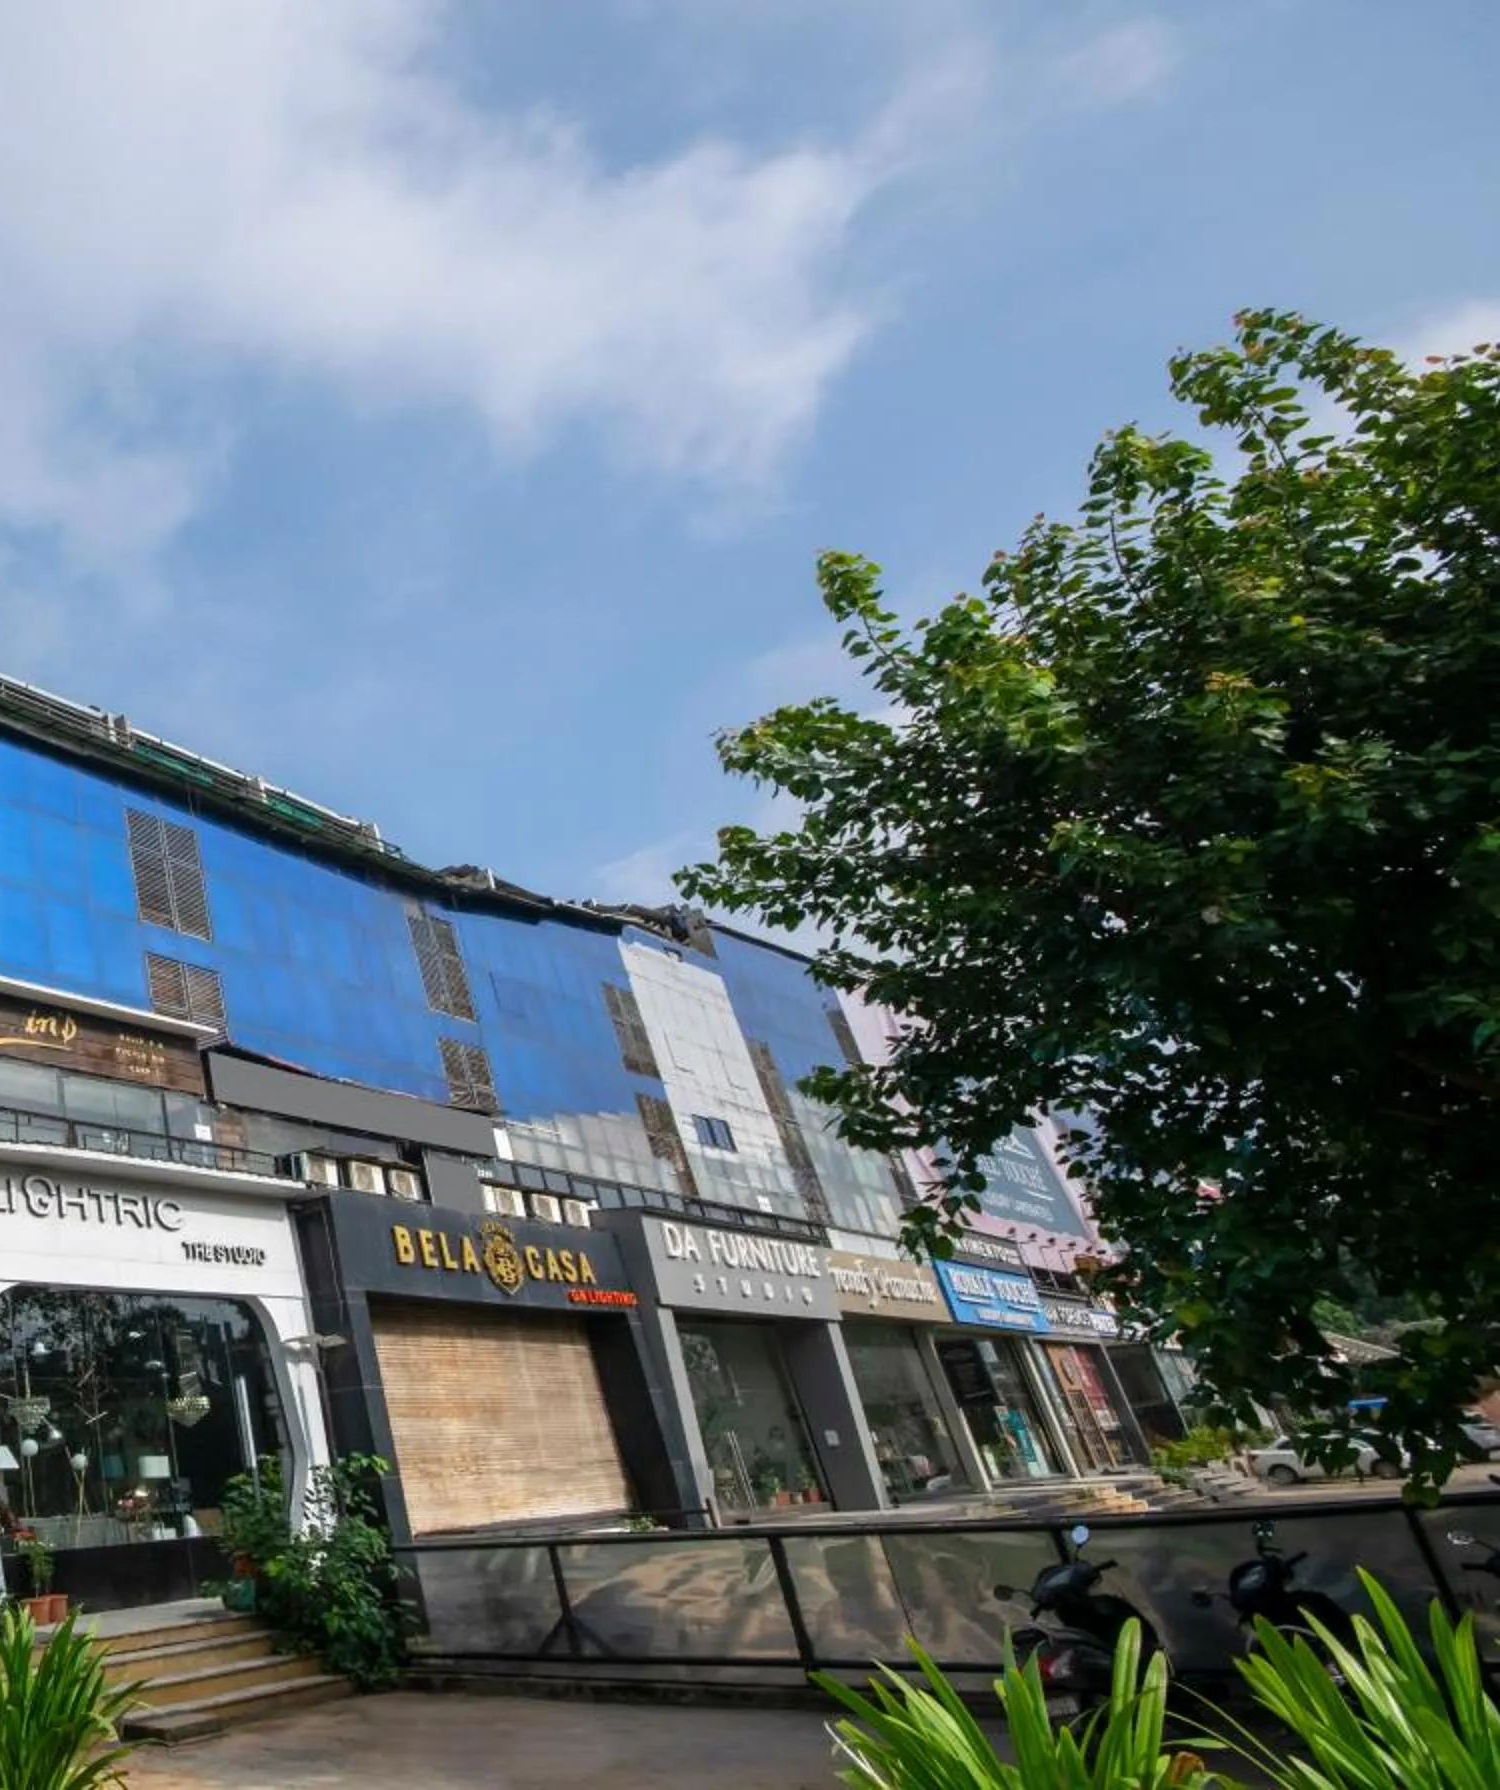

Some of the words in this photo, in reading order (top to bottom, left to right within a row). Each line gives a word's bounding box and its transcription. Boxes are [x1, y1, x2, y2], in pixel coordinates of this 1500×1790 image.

[181, 1242, 213, 1262] THE
[214, 1245, 266, 1267] STUDIO
[392, 1225, 481, 1273] BELA
[525, 1244, 598, 1285] CASA
[662, 1222, 701, 1263] DA
[706, 1227, 822, 1279] FURNITURE
[693, 1273, 814, 1304] STUDIO
